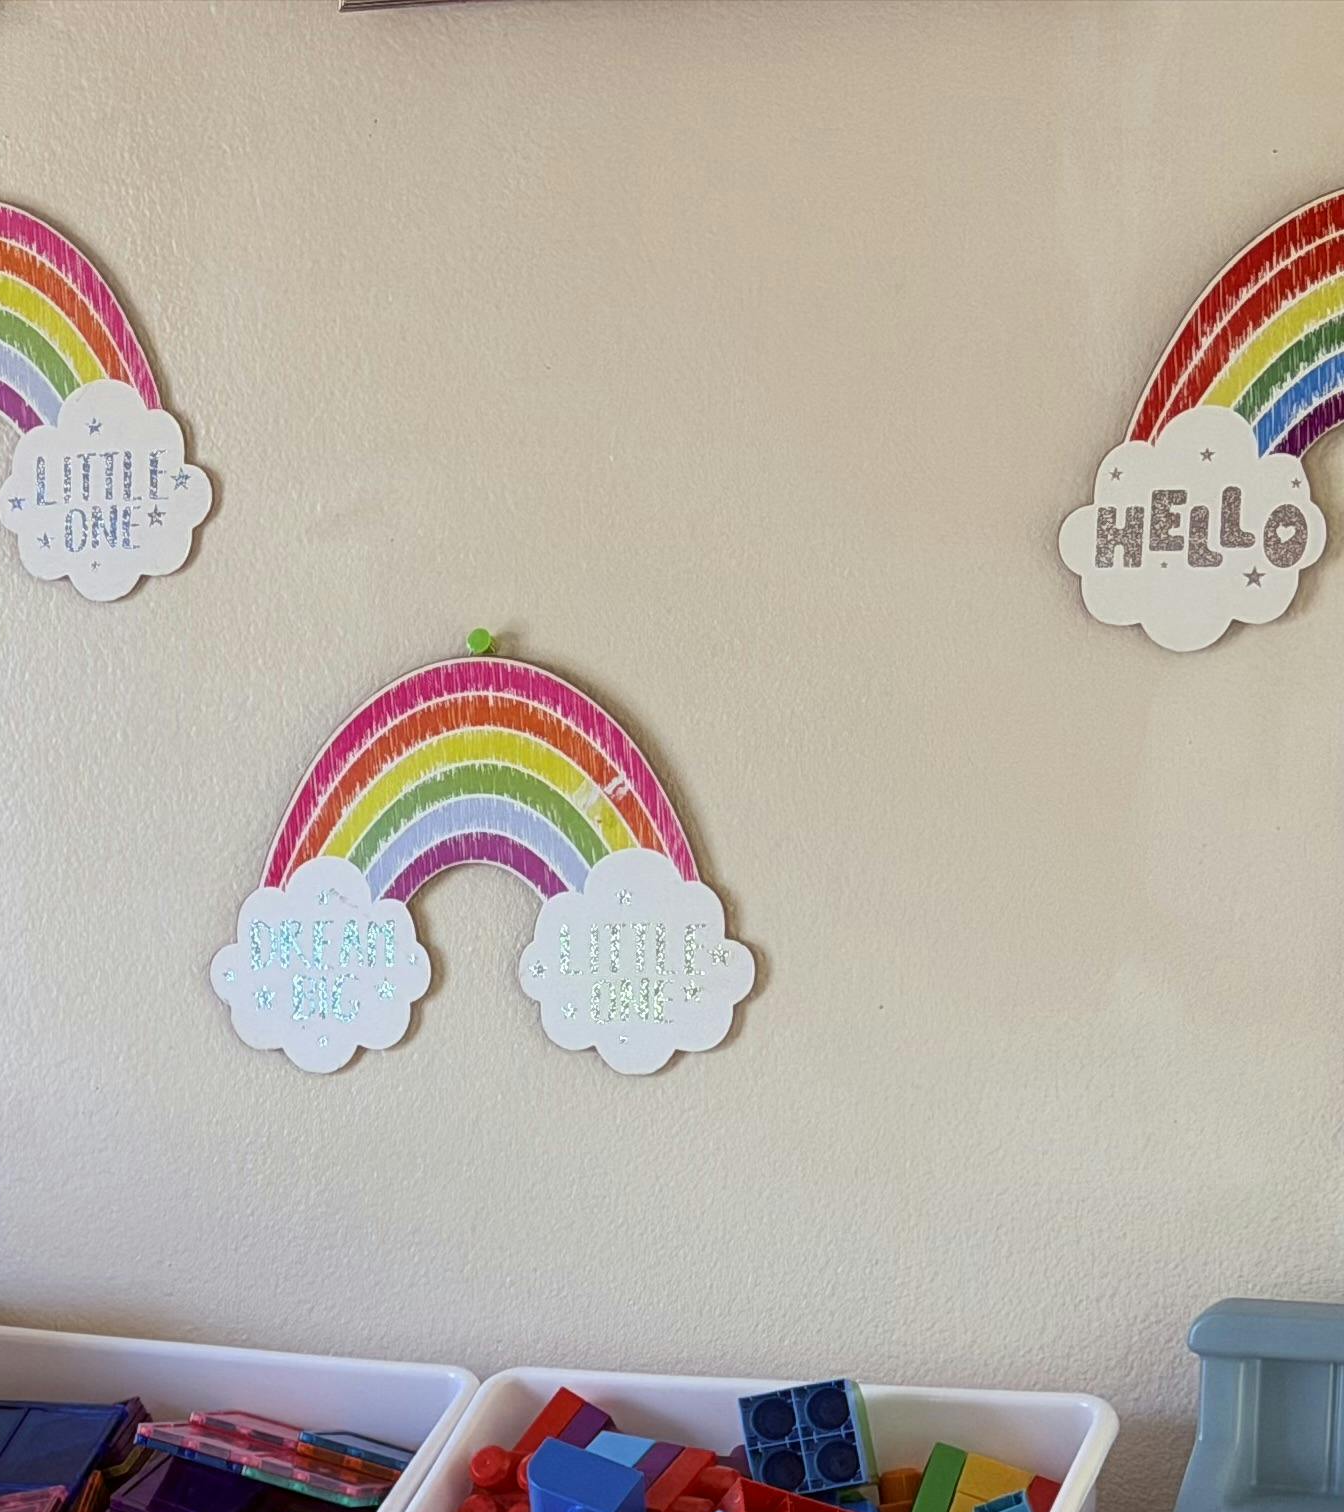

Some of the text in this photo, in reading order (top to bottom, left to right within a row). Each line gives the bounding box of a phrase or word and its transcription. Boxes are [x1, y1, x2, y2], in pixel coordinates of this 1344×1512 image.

[34, 449, 169, 507] LITTLE
[63, 505, 140, 553] ONE
[1095, 486, 1309, 568] HELLO
[248, 919, 396, 972] DREAM
[558, 920, 708, 976] LITTLE
[290, 973, 361, 1023] BIG
[587, 979, 675, 1025] ONE
